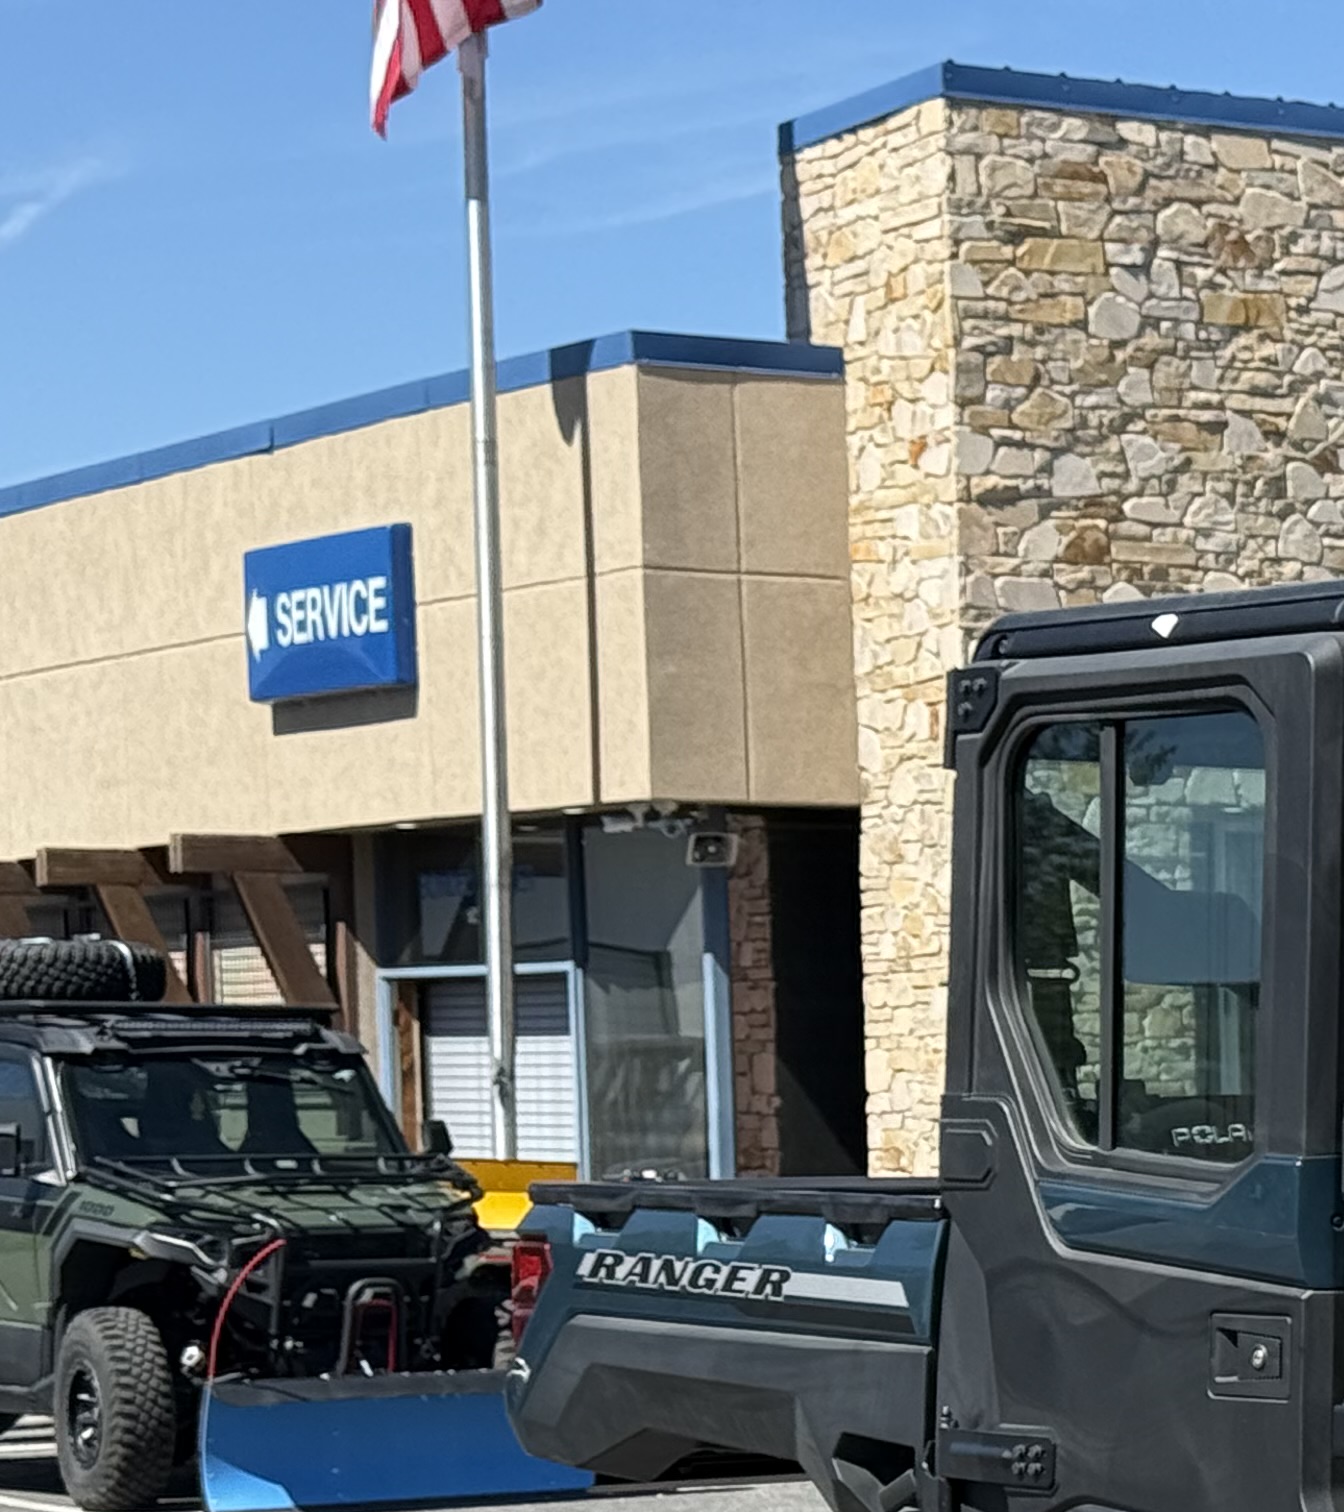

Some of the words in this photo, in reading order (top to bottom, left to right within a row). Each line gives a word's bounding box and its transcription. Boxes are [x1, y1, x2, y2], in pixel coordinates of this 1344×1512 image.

[276, 575, 389, 648] SERVICE
[1170, 1123, 1253, 1147] POLA
[586, 1250, 791, 1300] RANGER
